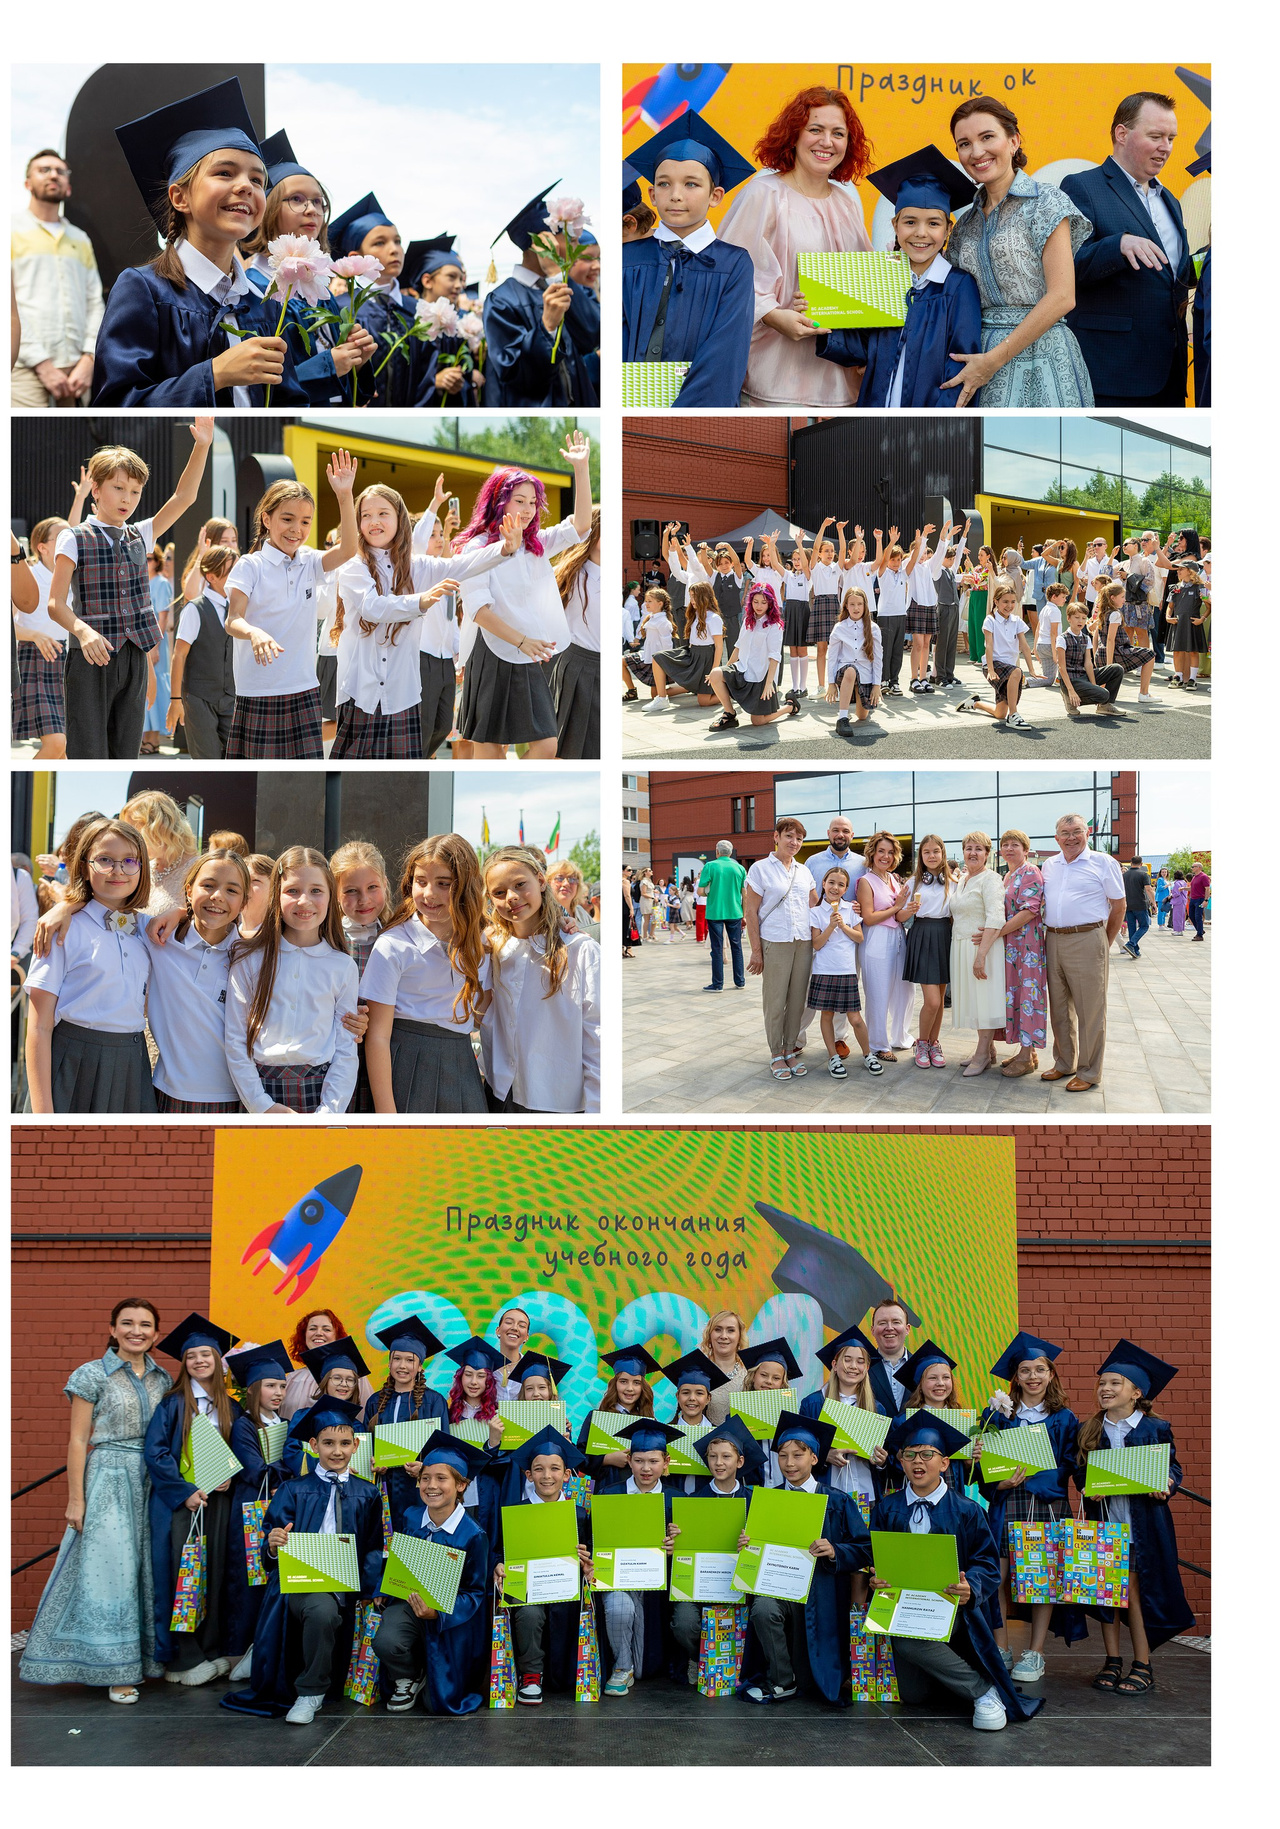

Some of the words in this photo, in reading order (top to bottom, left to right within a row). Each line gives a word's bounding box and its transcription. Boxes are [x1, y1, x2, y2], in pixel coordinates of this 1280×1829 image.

[837, 65, 983, 104] Праздник
[1004, 68, 1036, 90] ок
[446, 1207, 580, 1242] Праздник
[598, 1213, 746, 1232] окончания
[543, 1241, 668, 1277] учебного
[686, 1251, 748, 1279] года
